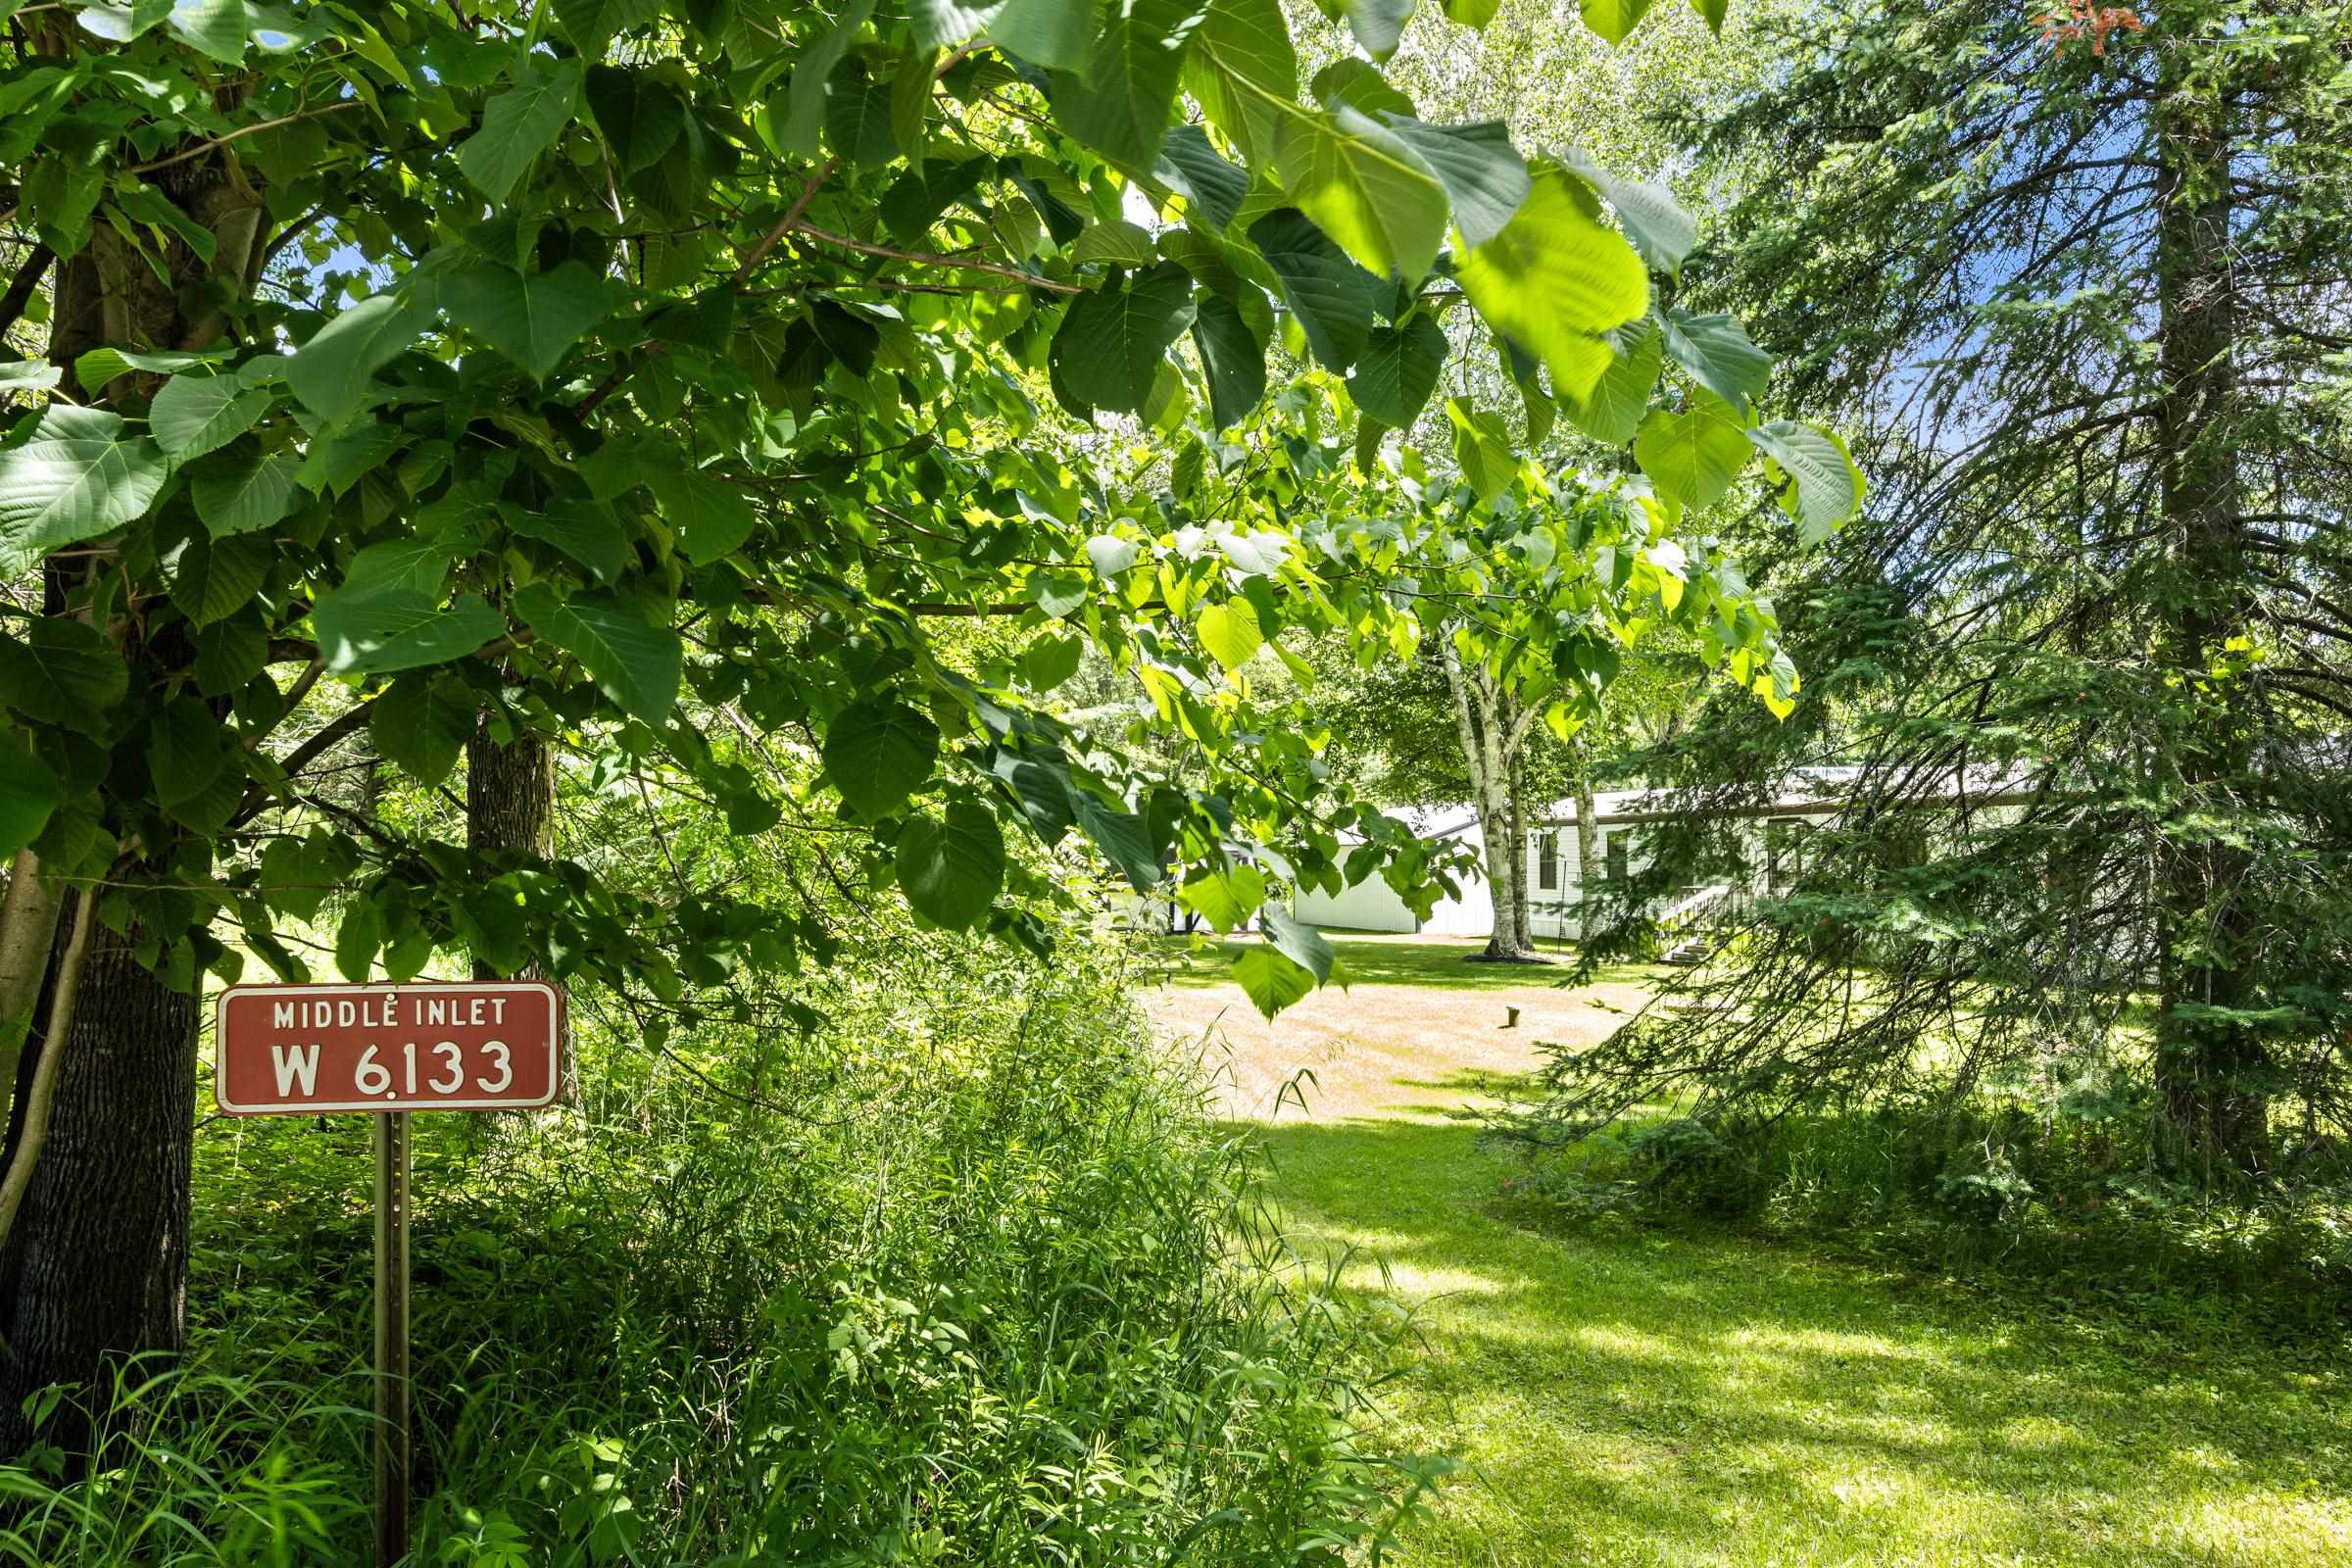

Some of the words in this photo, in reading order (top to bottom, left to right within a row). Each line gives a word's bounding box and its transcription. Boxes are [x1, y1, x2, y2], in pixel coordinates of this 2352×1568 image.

[273, 1000, 399, 1029] MIDDLE
[416, 999, 507, 1026] INLET
[271, 1044, 321, 1098] W
[354, 1041, 514, 1096] 6133
